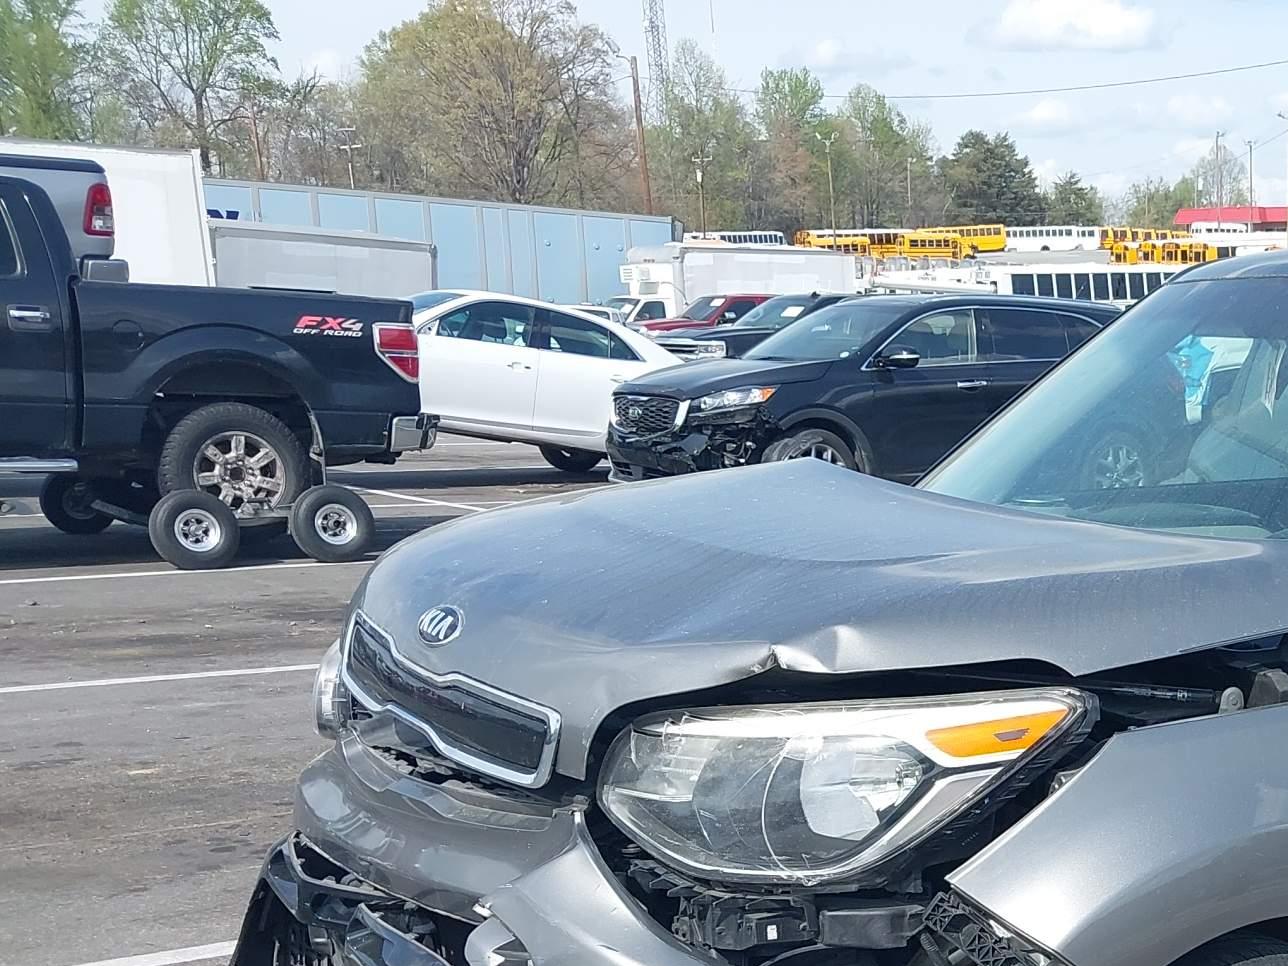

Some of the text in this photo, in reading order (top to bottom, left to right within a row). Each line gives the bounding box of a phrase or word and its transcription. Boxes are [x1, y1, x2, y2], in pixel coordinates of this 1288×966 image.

[294, 315, 364, 331] FX4
[323, 329, 363, 337] ROAD
[420, 608, 454, 640] KIA
